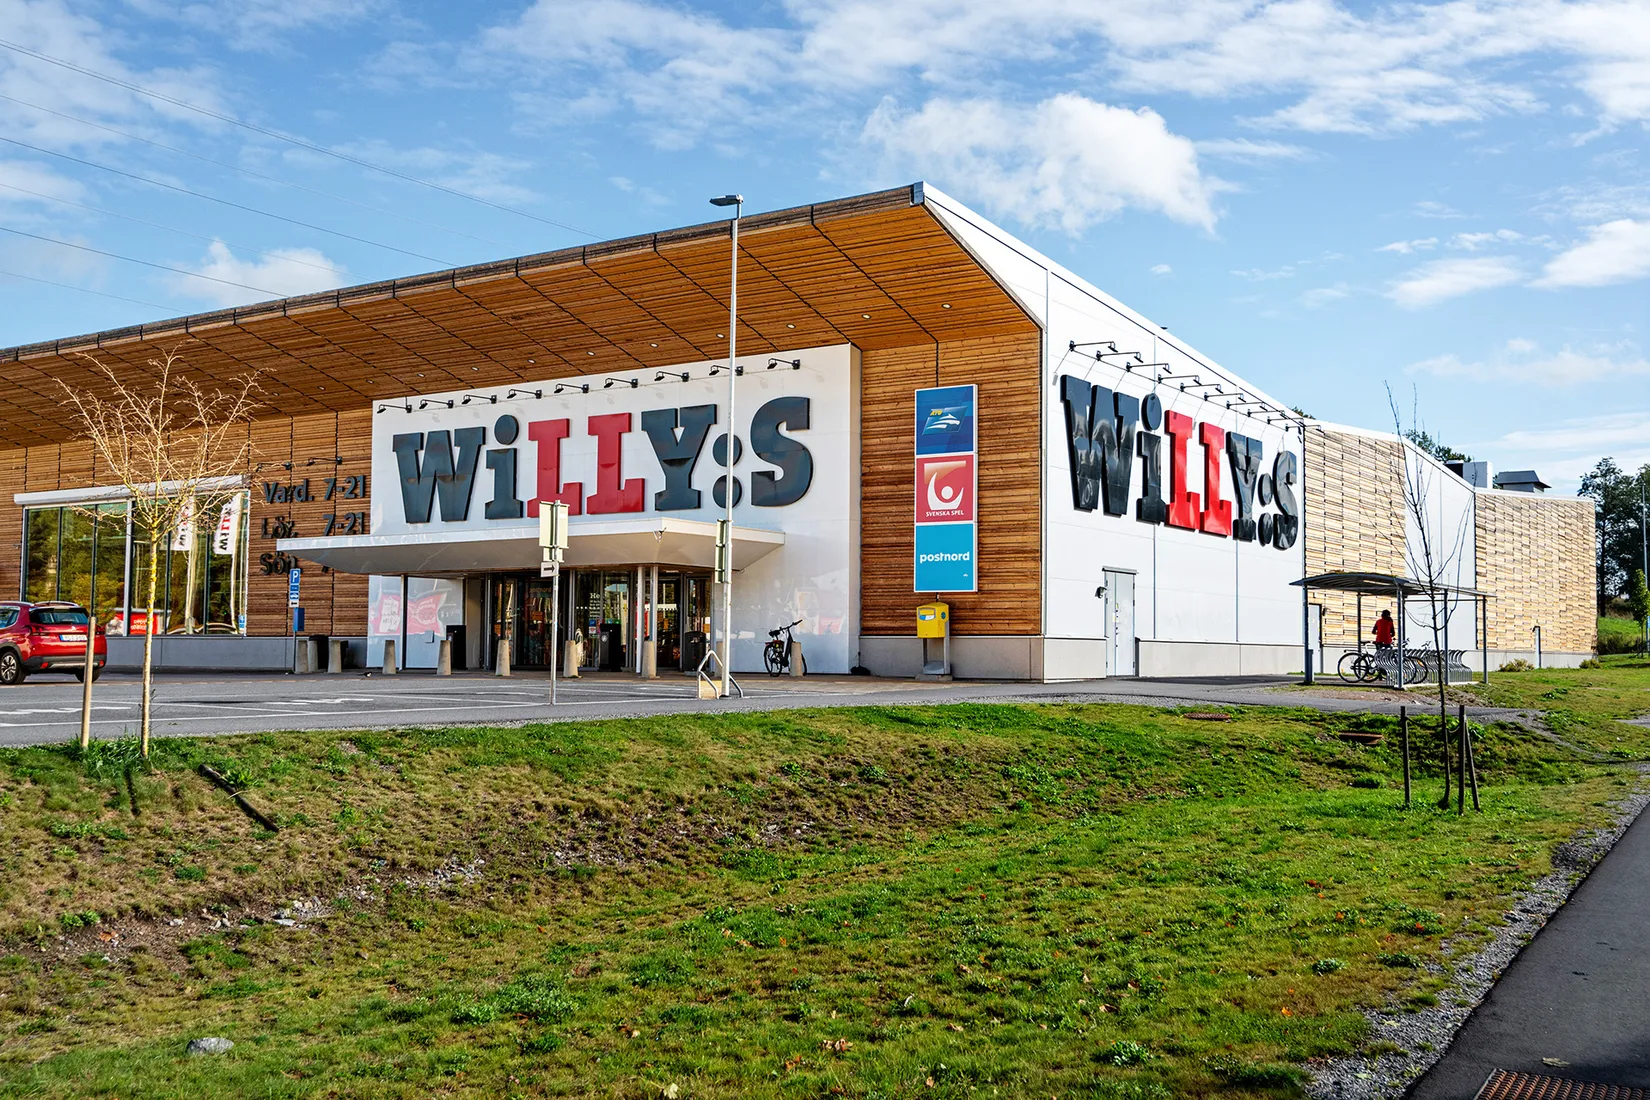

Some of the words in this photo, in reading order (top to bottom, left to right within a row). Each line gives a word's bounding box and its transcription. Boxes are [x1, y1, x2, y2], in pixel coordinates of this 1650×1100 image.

[392, 396, 814, 524] WiLLY:S
[1060, 374, 1299, 551] WiLLY:S
[263, 478, 315, 504] Vard.
[323, 475, 366, 501] 7-21
[260, 515, 299, 539] Lör.
[322, 511, 364, 536] 7-21
[260, 551, 303, 575] Sön
[920, 551, 970, 564] postnord
[292, 570, 299, 583] P
